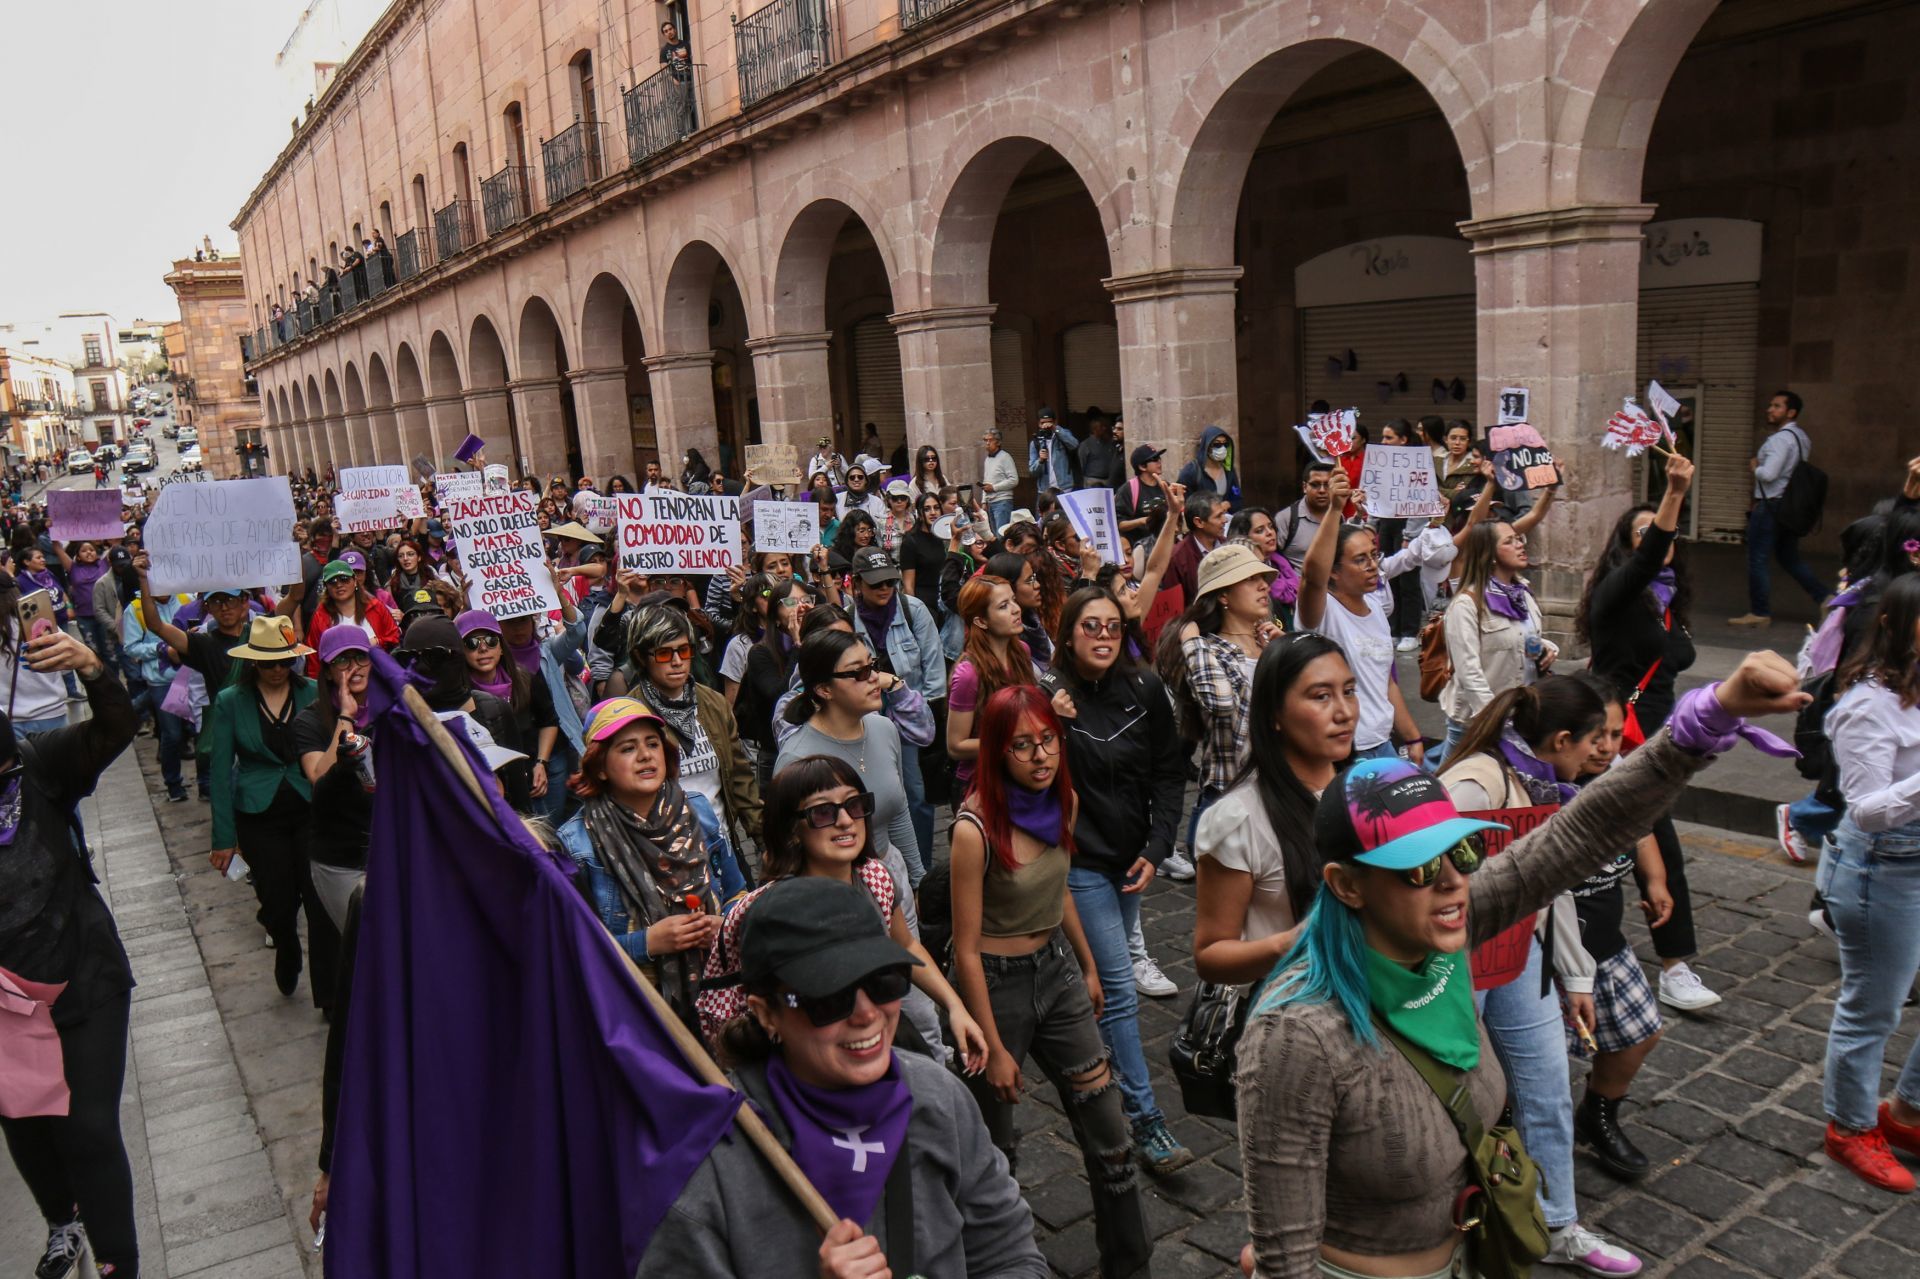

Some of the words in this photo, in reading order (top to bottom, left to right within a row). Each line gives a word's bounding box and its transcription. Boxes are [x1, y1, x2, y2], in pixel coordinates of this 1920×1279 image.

[1392, 452, 1410, 469] ES
[1416, 452, 1426, 469] EL
[1512, 448, 1532, 469] NO
[1535, 451, 1553, 465] nos
[1363, 469, 1382, 485] DE
[1391, 472, 1405, 487] LA
[1408, 471, 1428, 487] PAZ
[194, 487, 226, 516] NO
[342, 488, 390, 501] SEGURIDAD
[1390, 488, 1400, 501] EL
[618, 497, 643, 520] NO
[649, 496, 715, 521] TENDRAN
[719, 496, 741, 522] LA
[222, 521, 240, 546] DE
[348, 517, 400, 532] VIOLENCIA
[452, 522, 471, 539] NO
[473, 518, 498, 535] SOLO
[501, 511, 538, 531] DUELES
[473, 531, 522, 551] MATAS
[624, 524, 704, 548] COMODIDAD
[710, 525, 729, 544] DE
[152, 553, 184, 580] POR
[189, 553, 214, 580] UN
[225, 549, 297, 577] HOMBRE
[468, 542, 542, 568] SECUESTRAS
[622, 551, 674, 569] NUESTRO
[678, 549, 732, 569] SILENCIO
[480, 560, 525, 579] VIOLAS
[484, 573, 532, 591] GASEAS
[481, 585, 536, 605] OPRIMES
